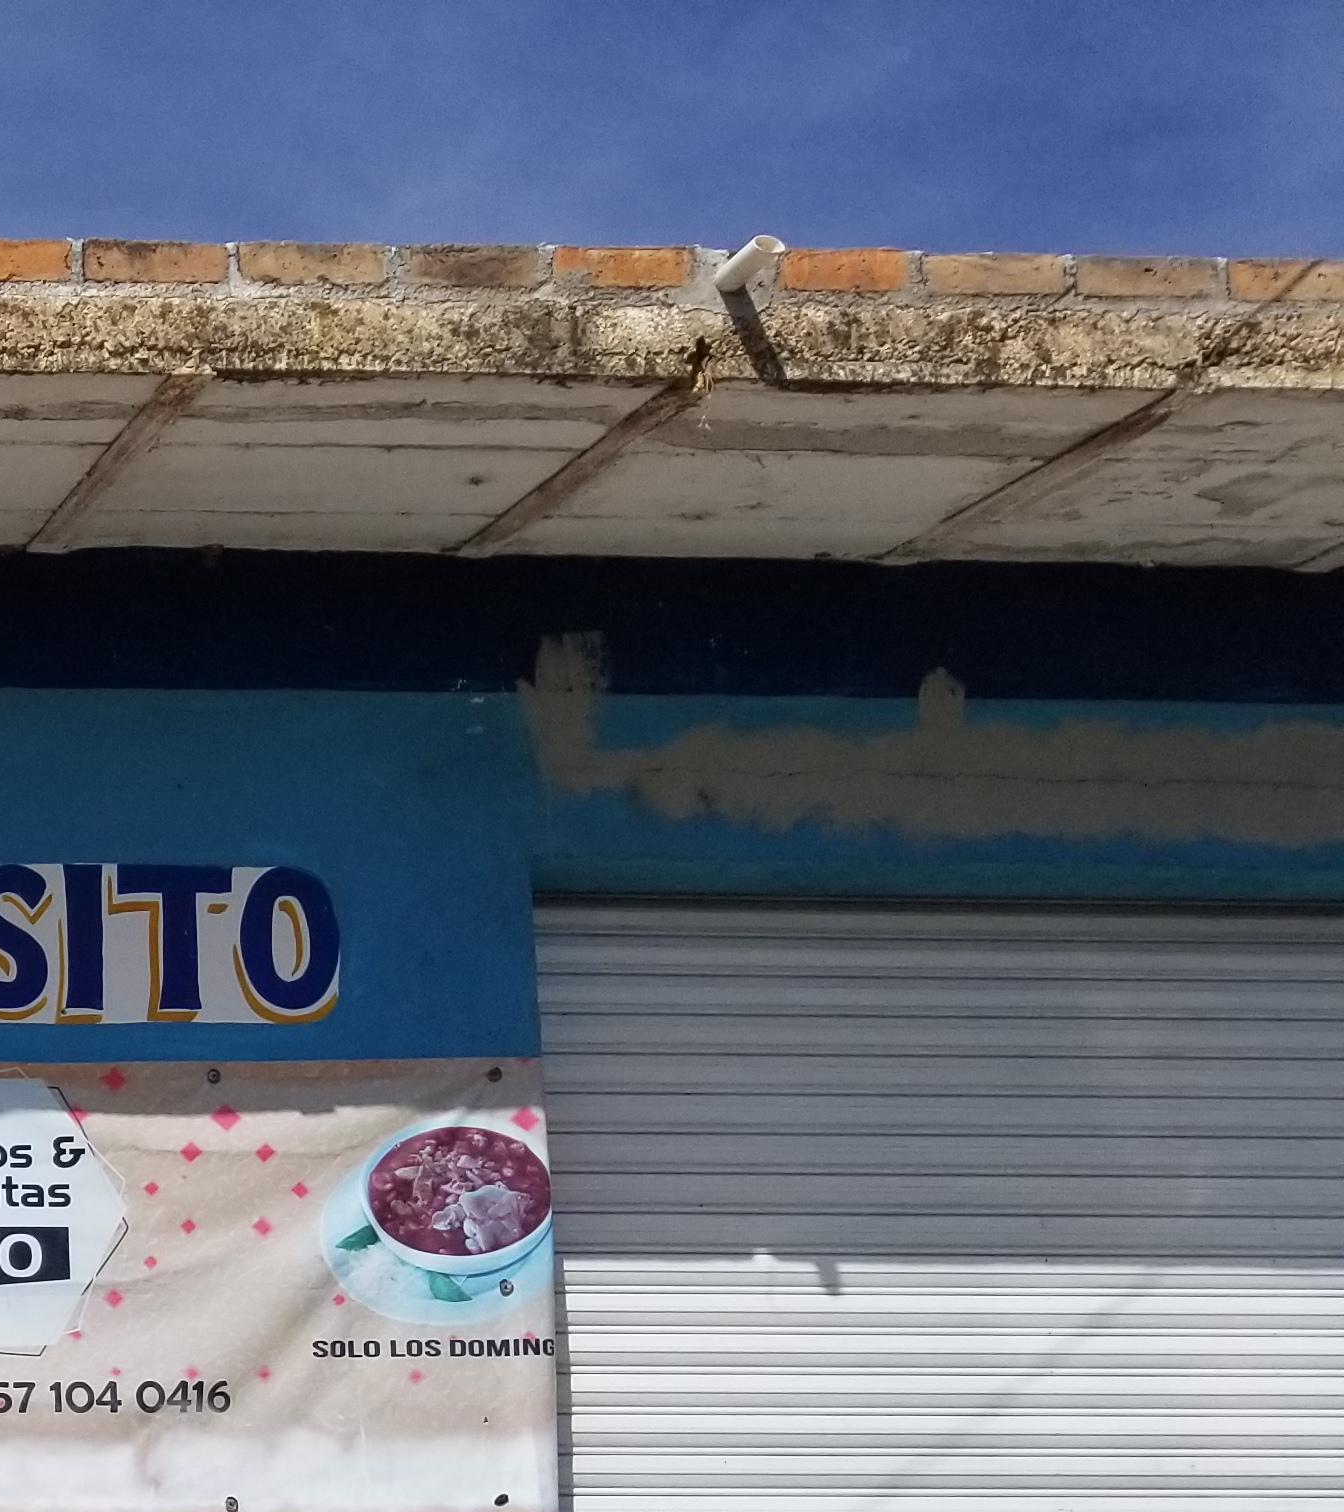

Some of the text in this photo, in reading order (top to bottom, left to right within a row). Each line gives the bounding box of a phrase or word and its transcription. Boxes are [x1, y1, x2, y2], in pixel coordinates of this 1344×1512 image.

[52, 1136, 86, 1168] &
[312, 1339, 381, 1358] SOLO
[389, 1339, 442, 1358] LOS
[49, 1381, 122, 1414] 104
[135, 1379, 232, 1415] 0416
